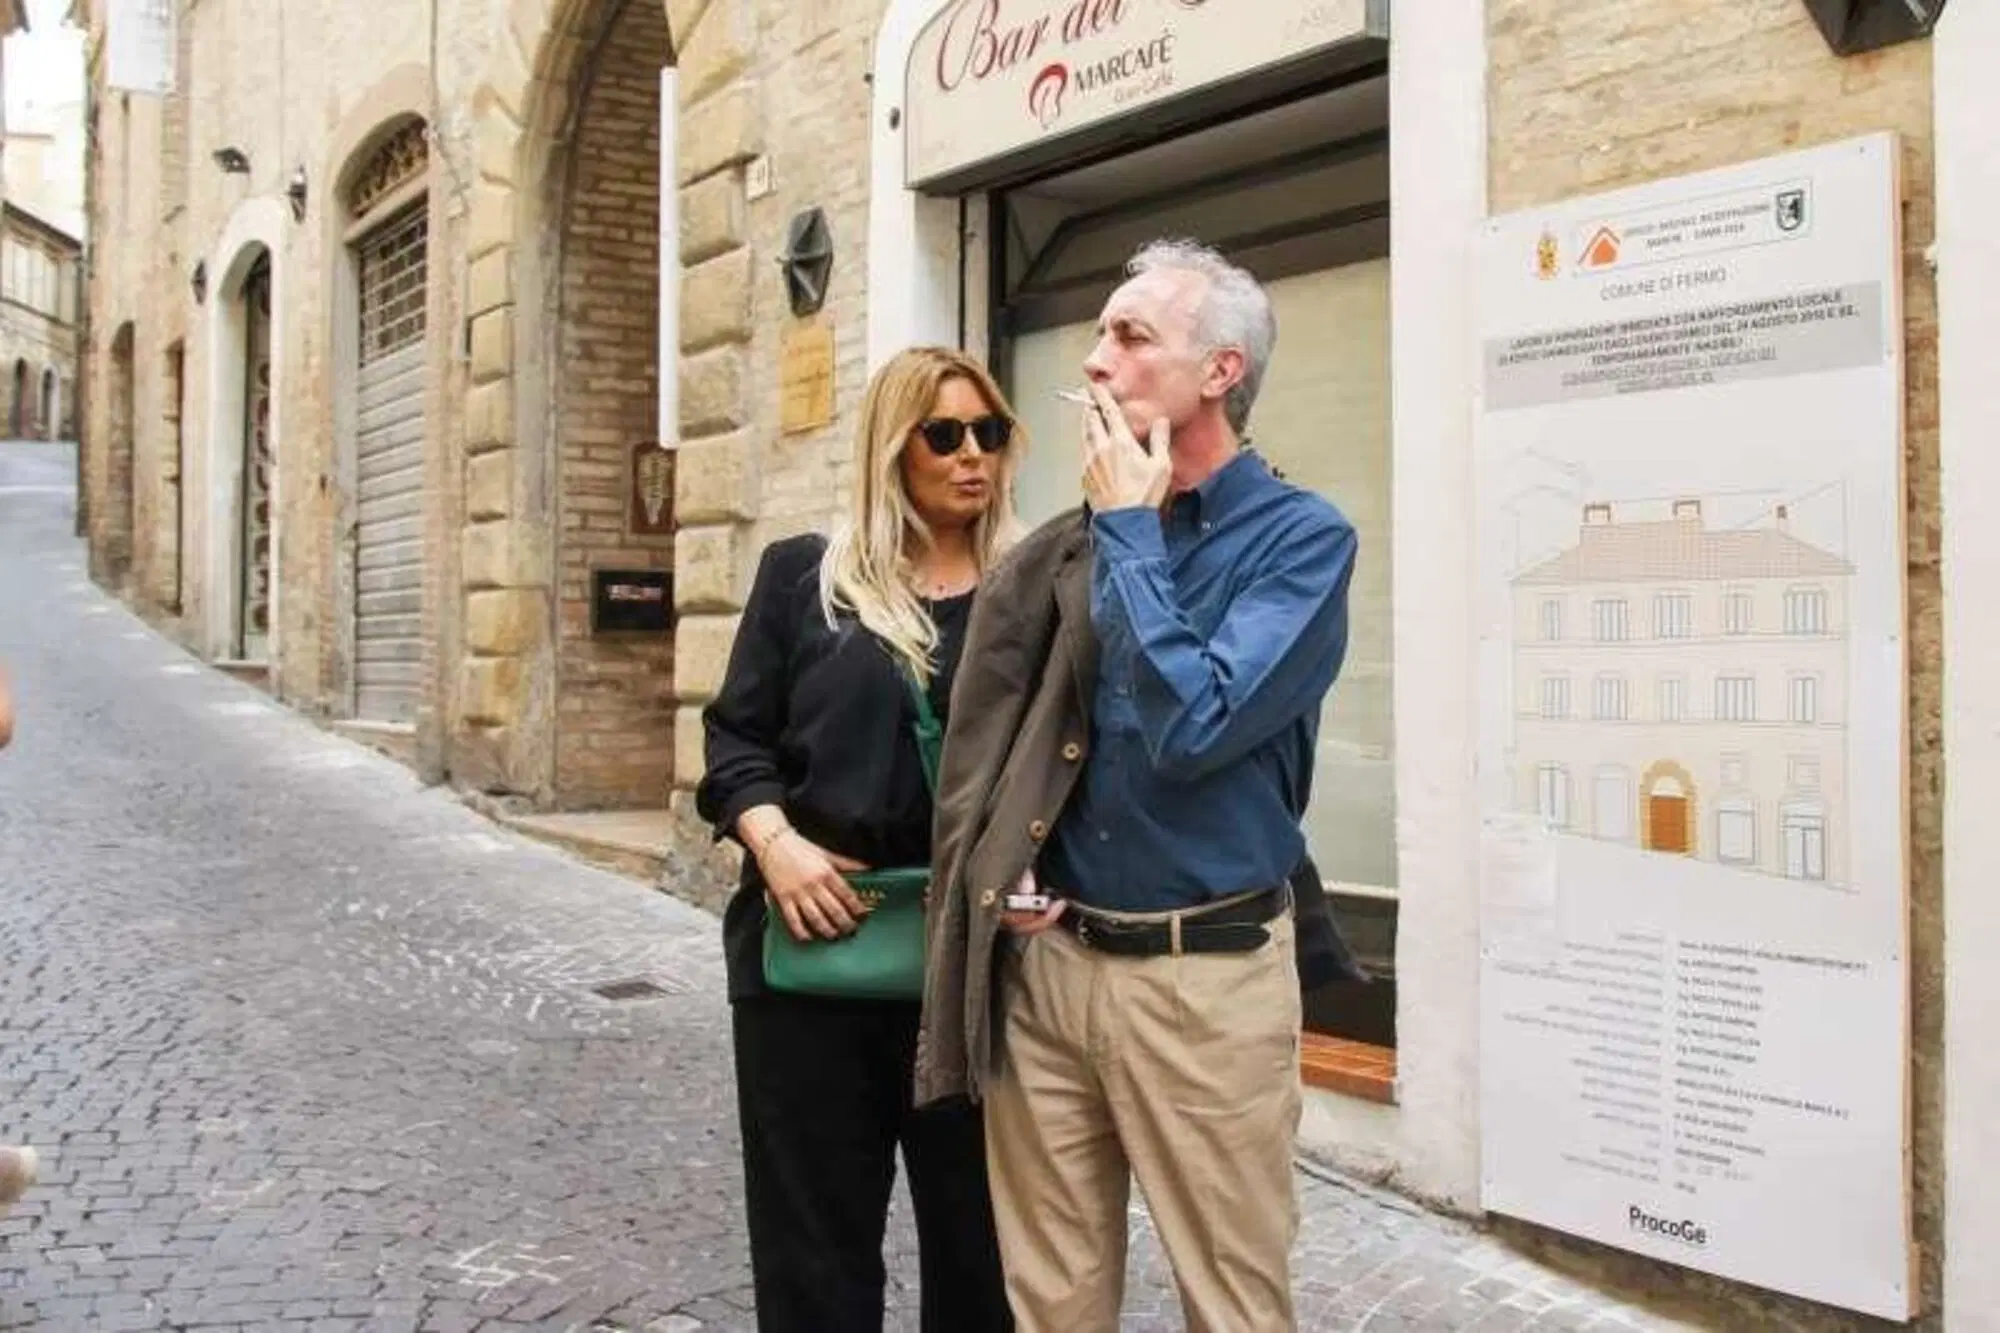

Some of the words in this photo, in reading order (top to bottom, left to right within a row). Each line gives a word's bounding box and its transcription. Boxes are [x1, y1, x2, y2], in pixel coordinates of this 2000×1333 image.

[936, 0, 1050, 92] Bar
[1600, 279, 1656, 301] COMUNE
[1659, 276, 1674, 291] DI
[1677, 267, 1727, 289] FERMO
[1629, 1205, 1706, 1244] ProcoGe
